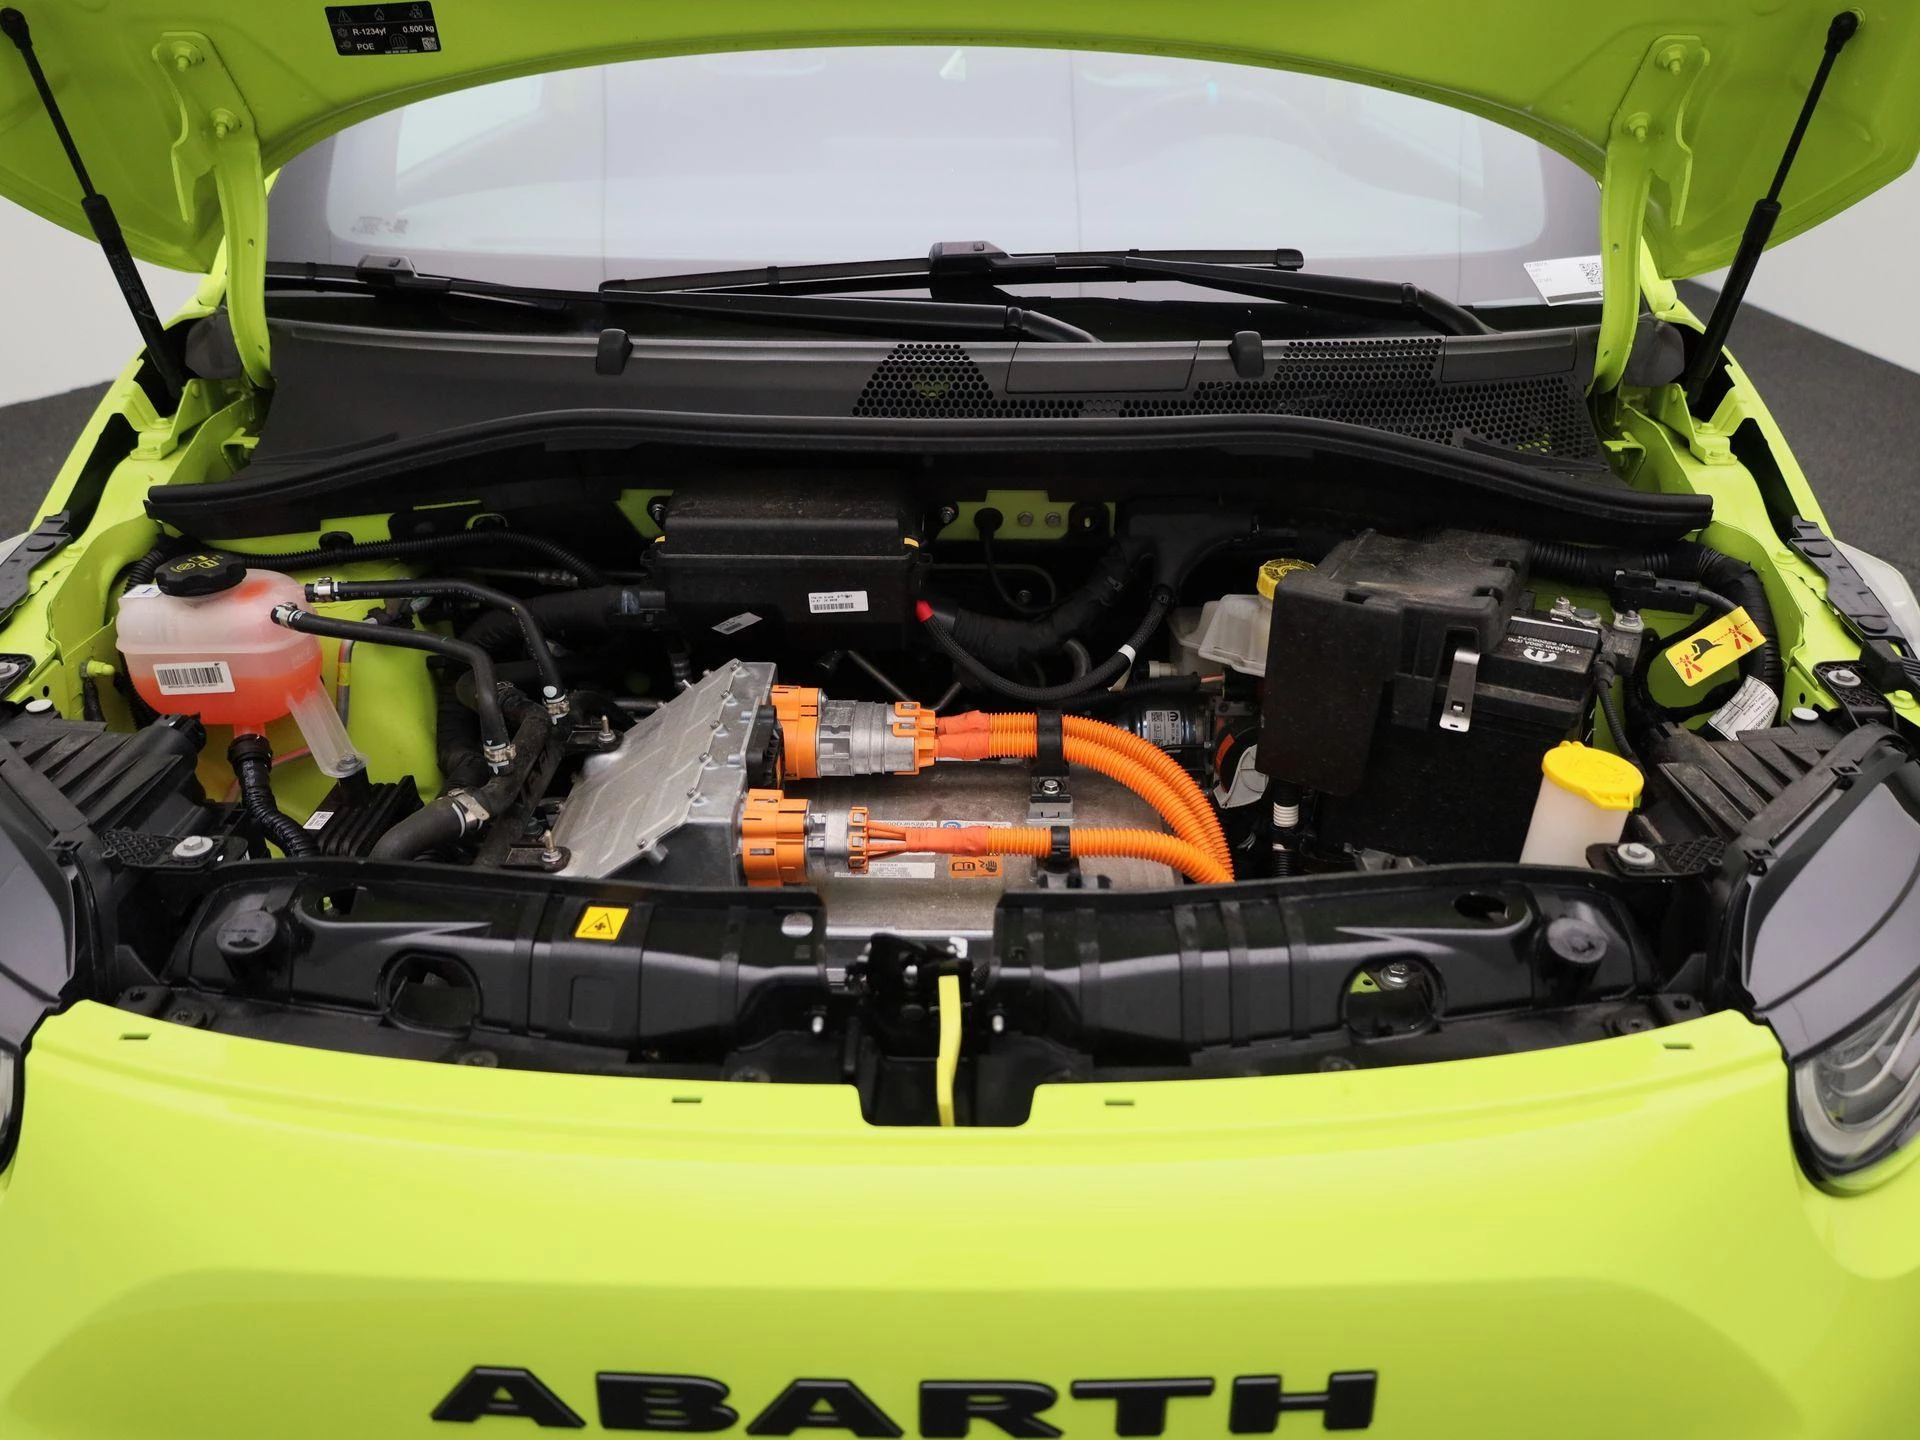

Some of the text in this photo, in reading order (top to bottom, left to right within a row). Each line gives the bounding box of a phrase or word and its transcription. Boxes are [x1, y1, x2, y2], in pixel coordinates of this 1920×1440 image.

[352, 25, 435, 36] R-1234yf 0.500 kg
[432, 1366, 1378, 1439] ABARTH
